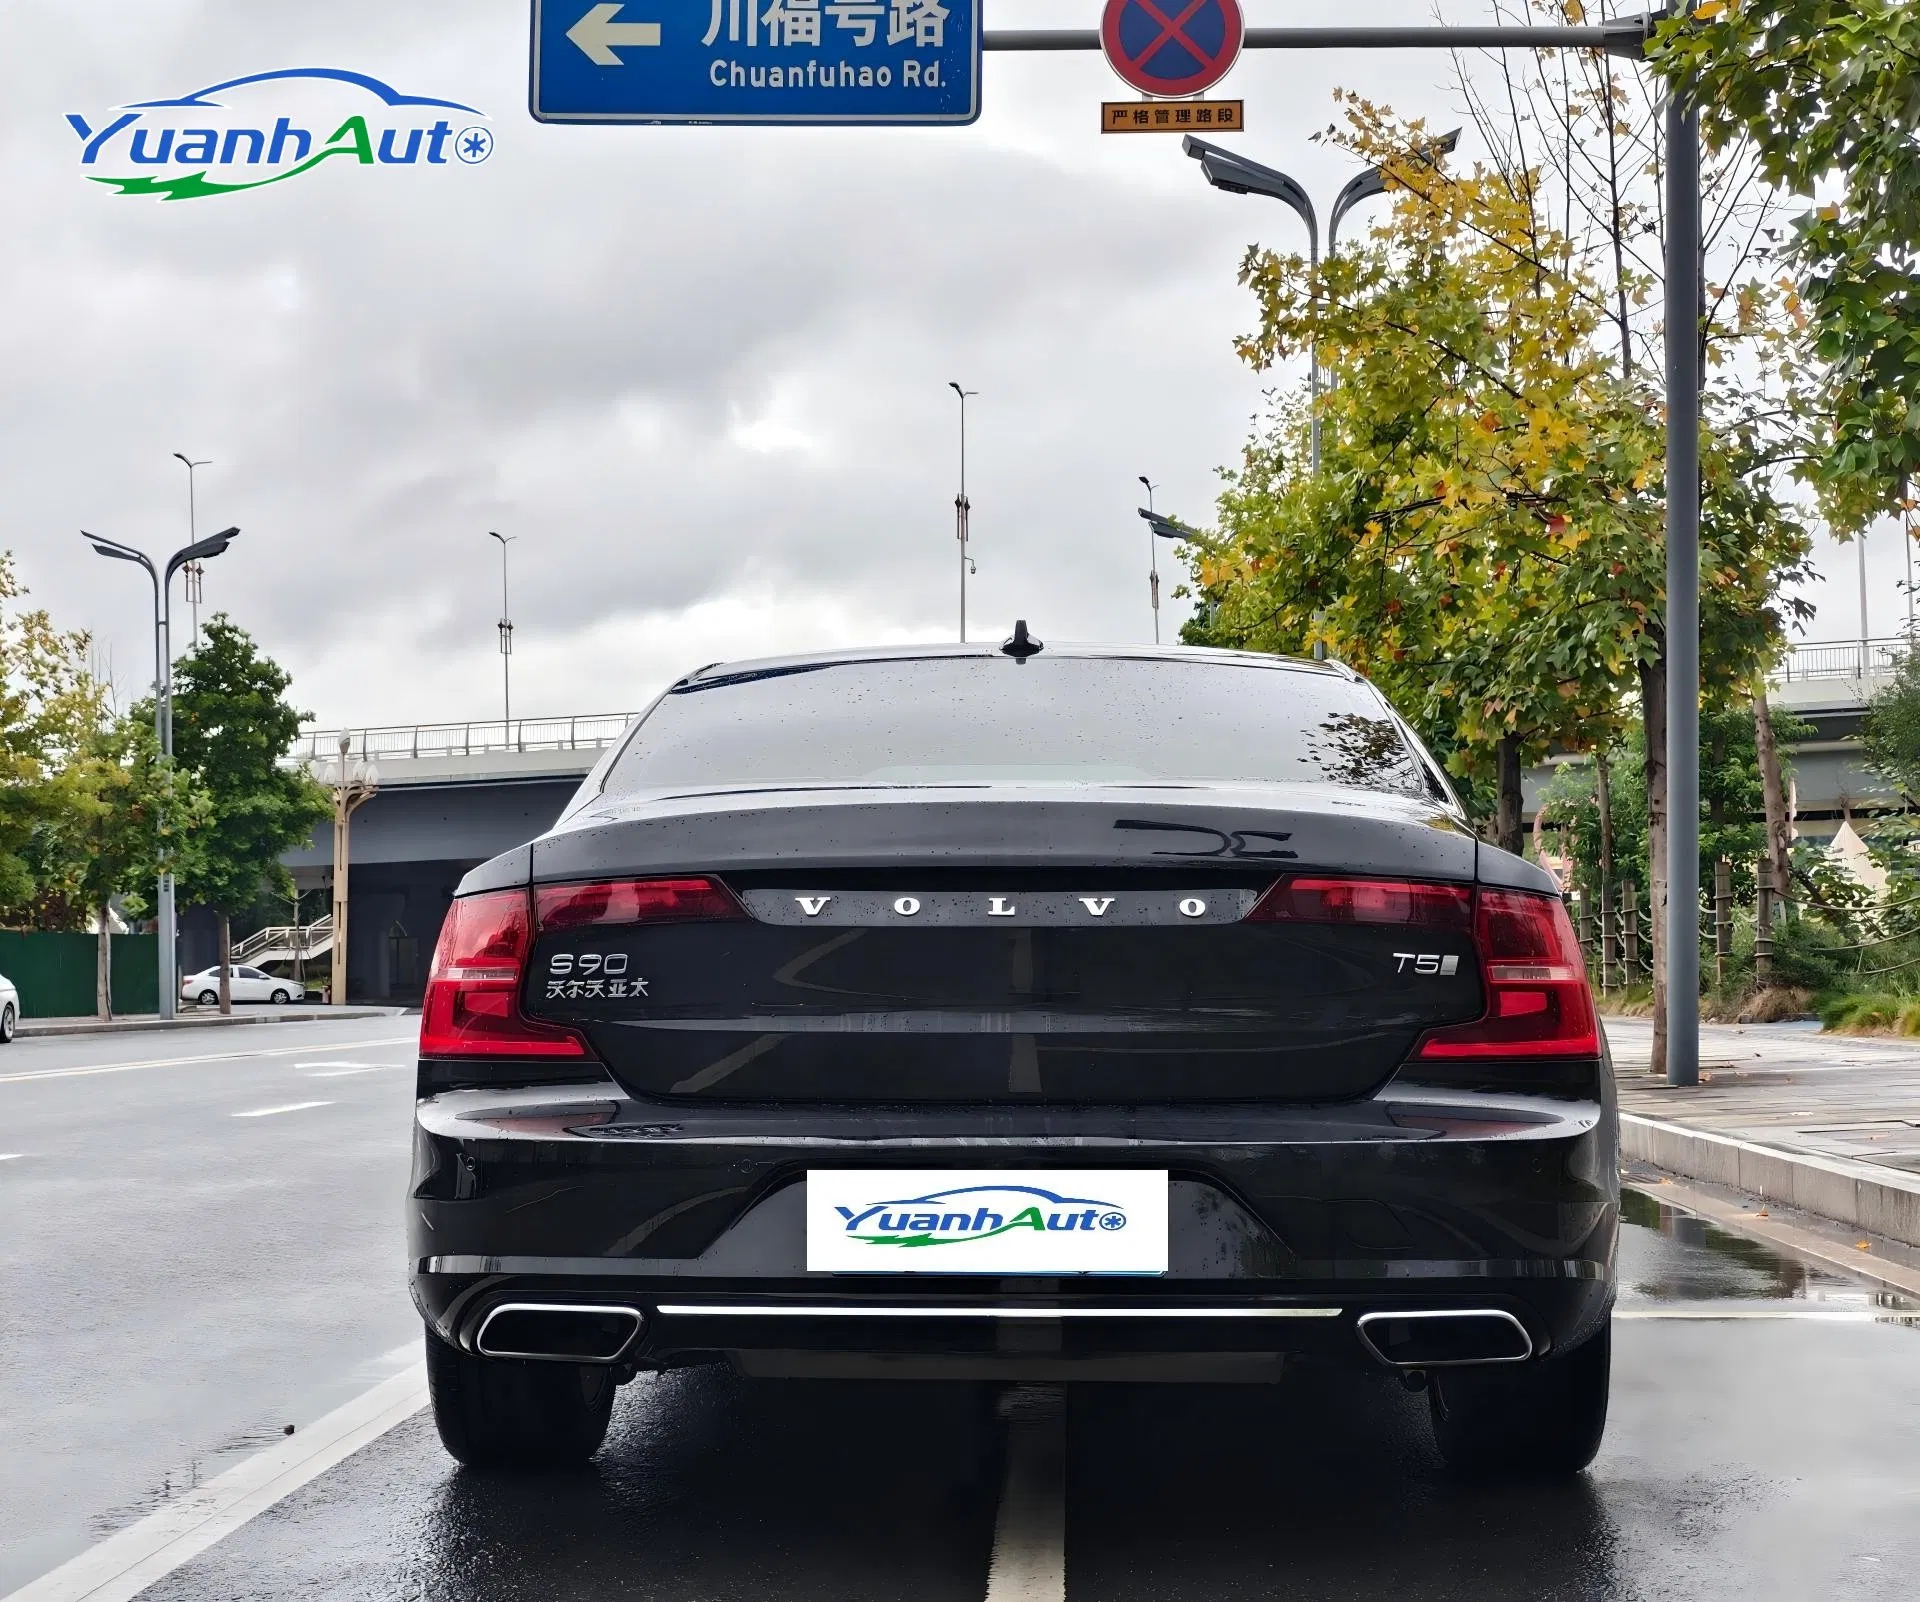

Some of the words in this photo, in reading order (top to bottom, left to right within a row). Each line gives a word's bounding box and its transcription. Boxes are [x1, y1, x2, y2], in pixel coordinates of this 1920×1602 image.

[701, 0, 951, 47] 川福号路
[709, 59, 892, 88] Chuanfuhao
[903, 59, 946, 88] Rd.
[1111, 108, 1234, 124] 严格管理路段
[795, 897, 1207, 917] VOLVO
[549, 953, 629, 976] S90
[1392, 952, 1440, 975] T5
[545, 977, 649, 999] 沃尔沃亚太
